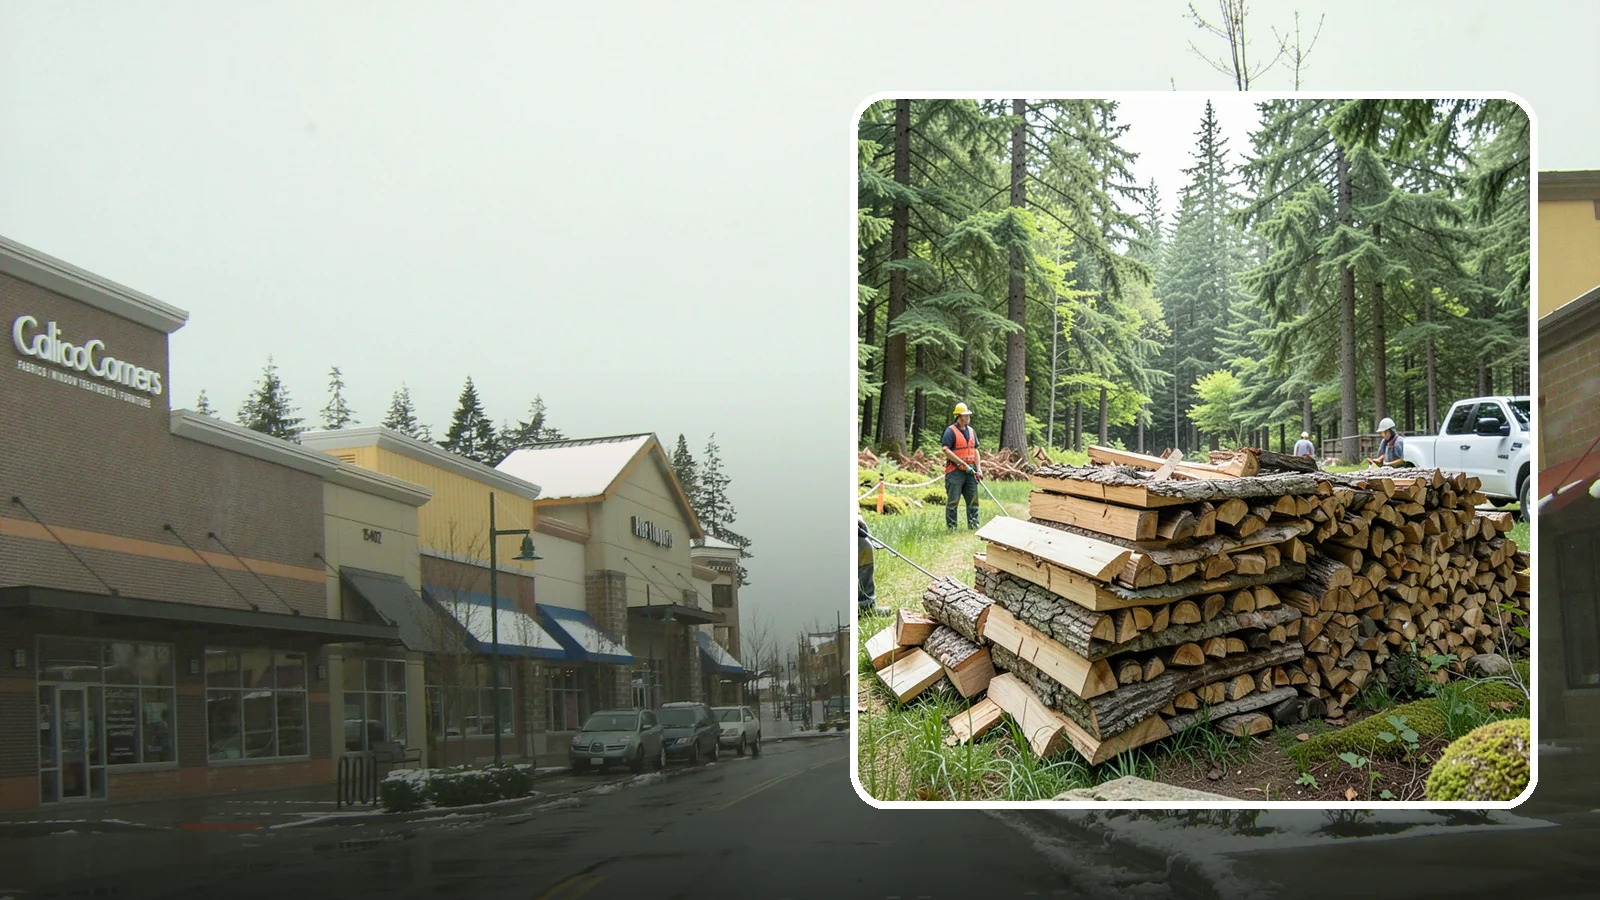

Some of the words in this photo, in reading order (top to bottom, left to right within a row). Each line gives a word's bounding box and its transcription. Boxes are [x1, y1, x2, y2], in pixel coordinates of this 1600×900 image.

[17, 359, 47, 378] FABRICS
[51, 369, 78, 387] WINDOW
[78, 378, 117, 399] TREATMENTS
